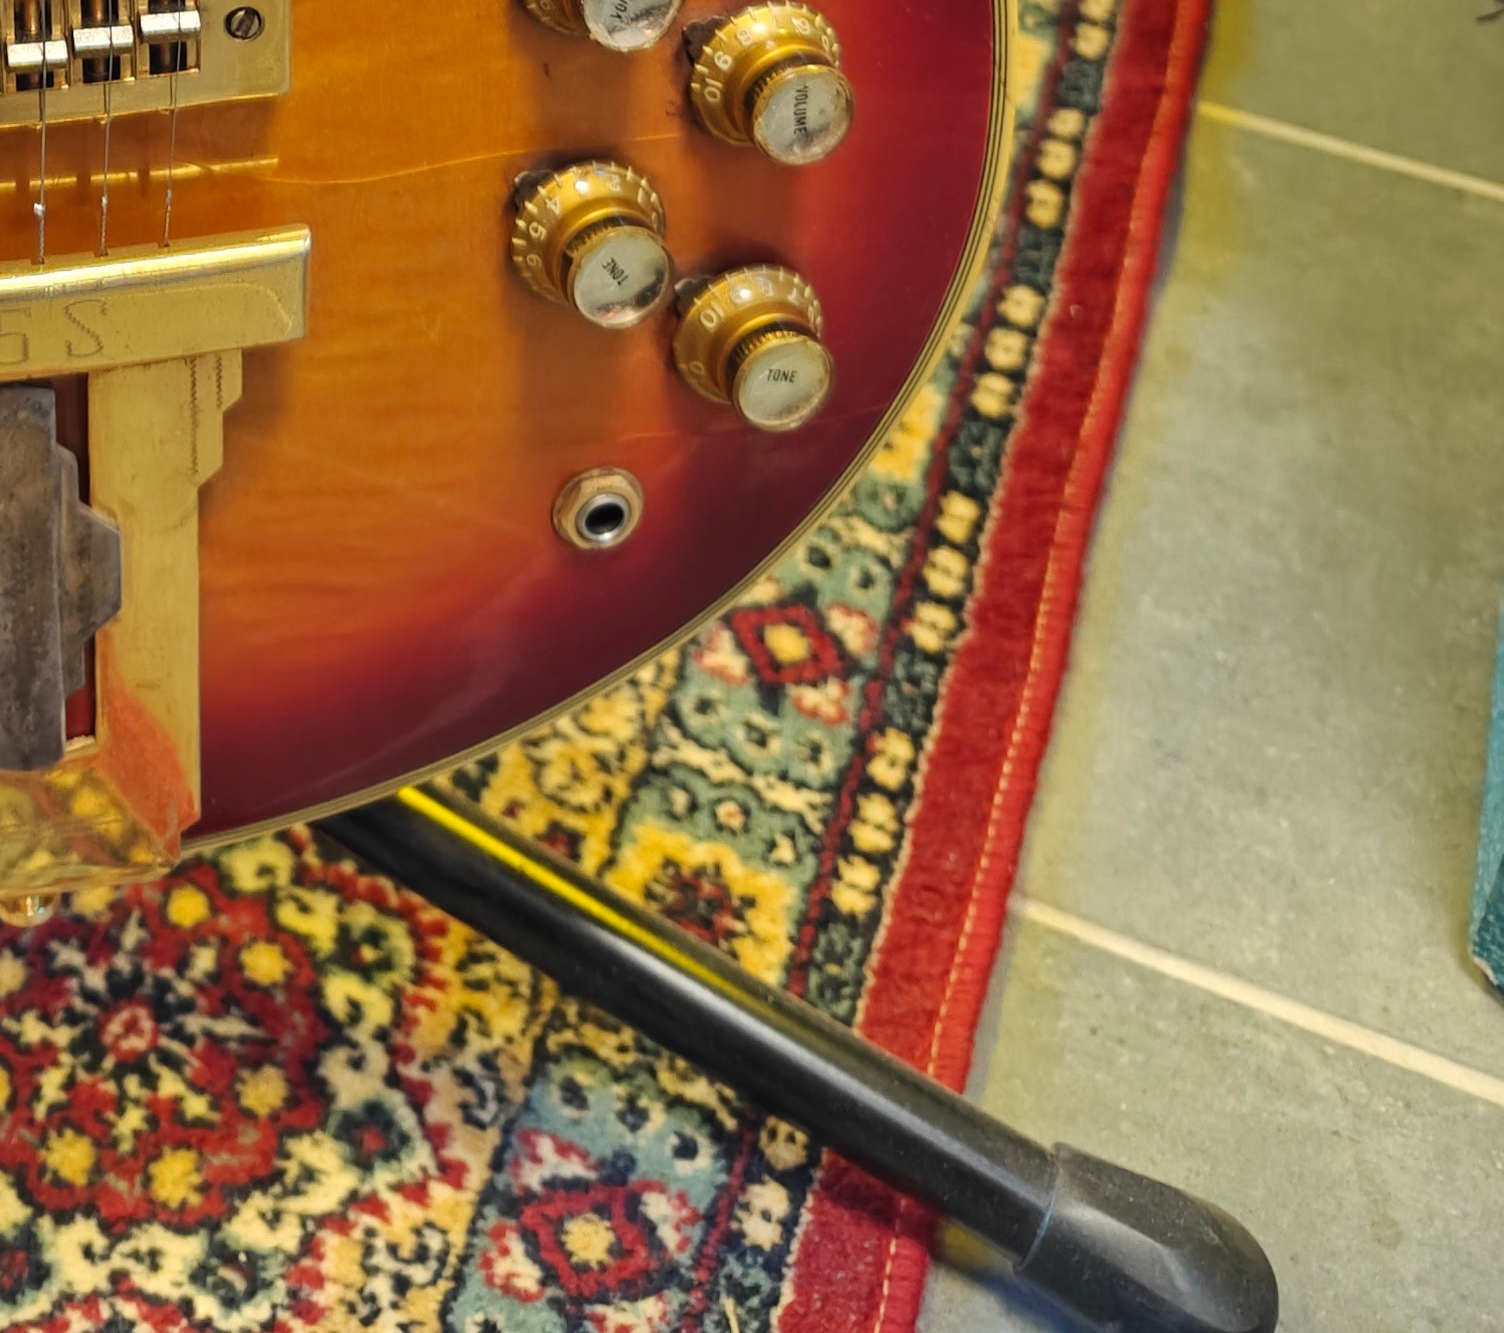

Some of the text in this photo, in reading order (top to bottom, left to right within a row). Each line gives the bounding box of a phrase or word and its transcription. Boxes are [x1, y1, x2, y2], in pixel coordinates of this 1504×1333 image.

[713, 51, 733, 71] 9
[703, 77, 723, 103] 10
[793, 85, 809, 135] VOLUME
[546, 197, 561, 214] 4
[529, 221, 546, 240] 5
[602, 257, 629, 286] TONE
[700, 301, 724, 330] 10
[766, 368, 798, 383] TONE
